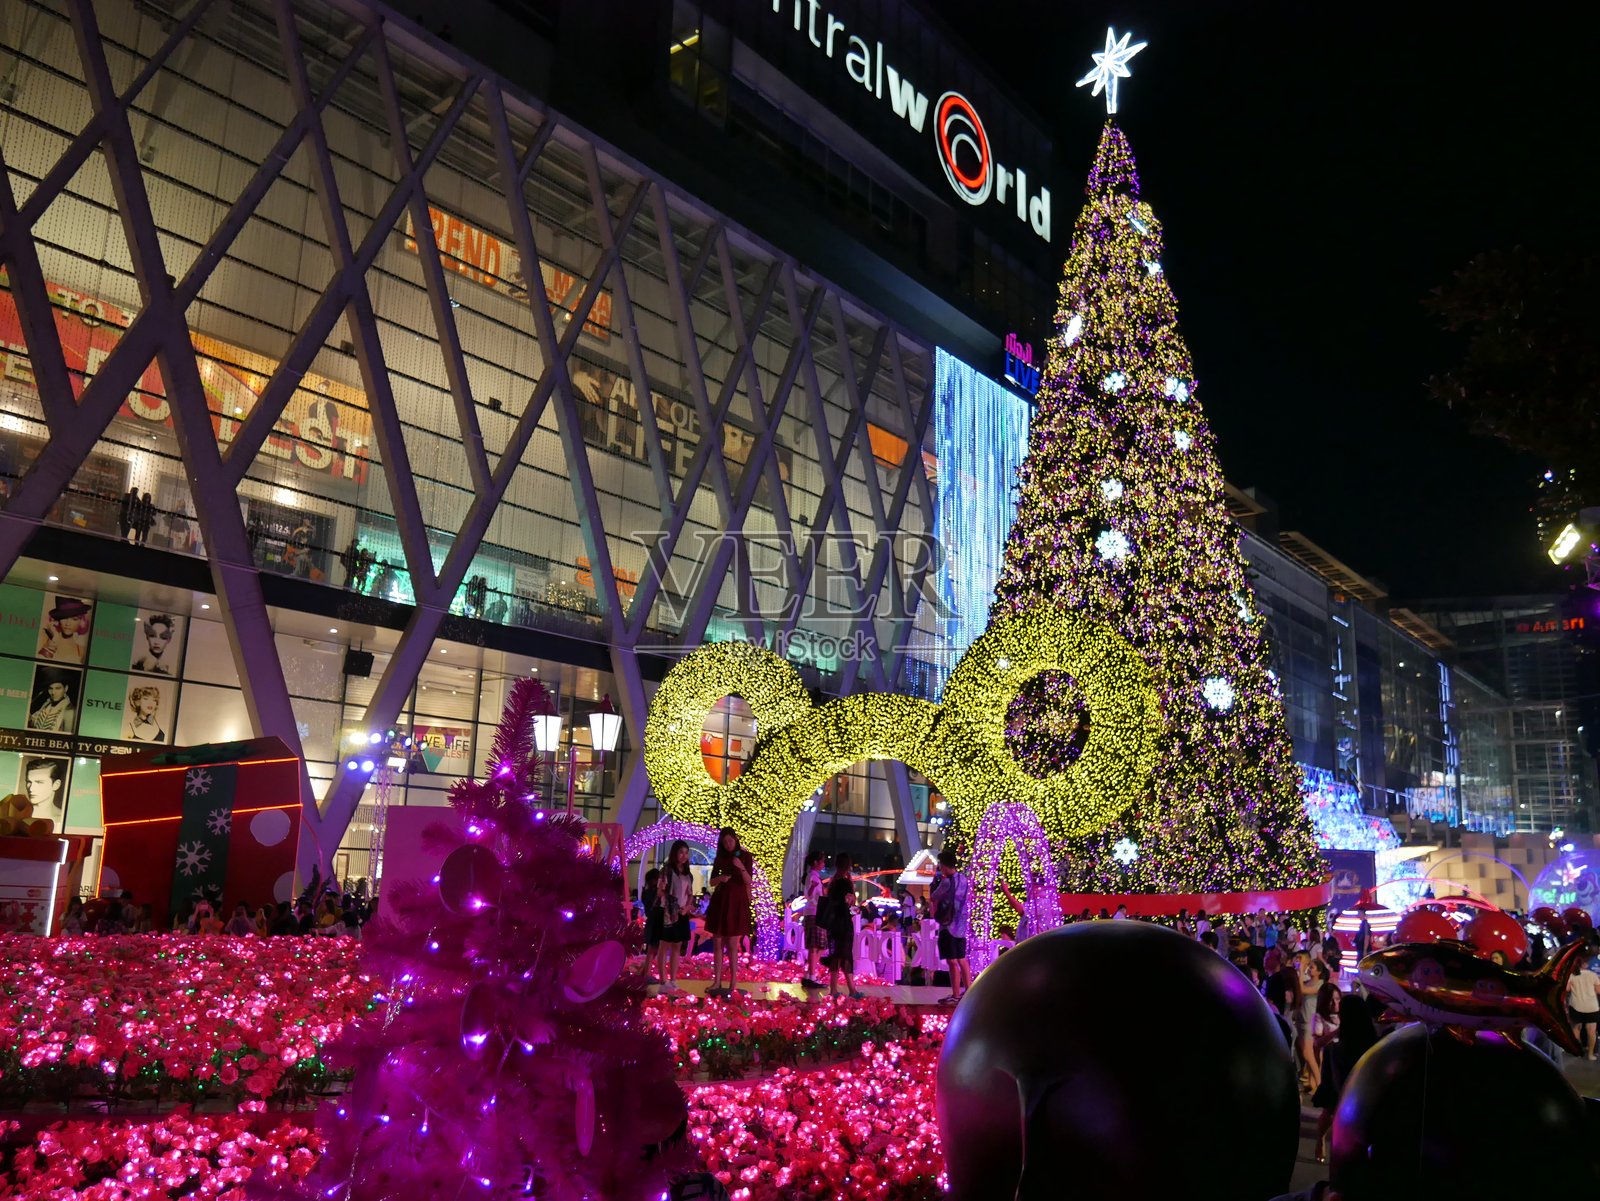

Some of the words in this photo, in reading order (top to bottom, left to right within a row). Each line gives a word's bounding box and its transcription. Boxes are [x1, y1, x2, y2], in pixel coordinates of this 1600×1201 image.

[1005, 351, 1040, 395] LIVE
[670, 401, 701, 433] OF
[86, 699, 123, 711] STYLE
[25, 737, 46, 748] THE
[94, 744, 109, 753] OF
[110, 745, 133, 755] ZEN
